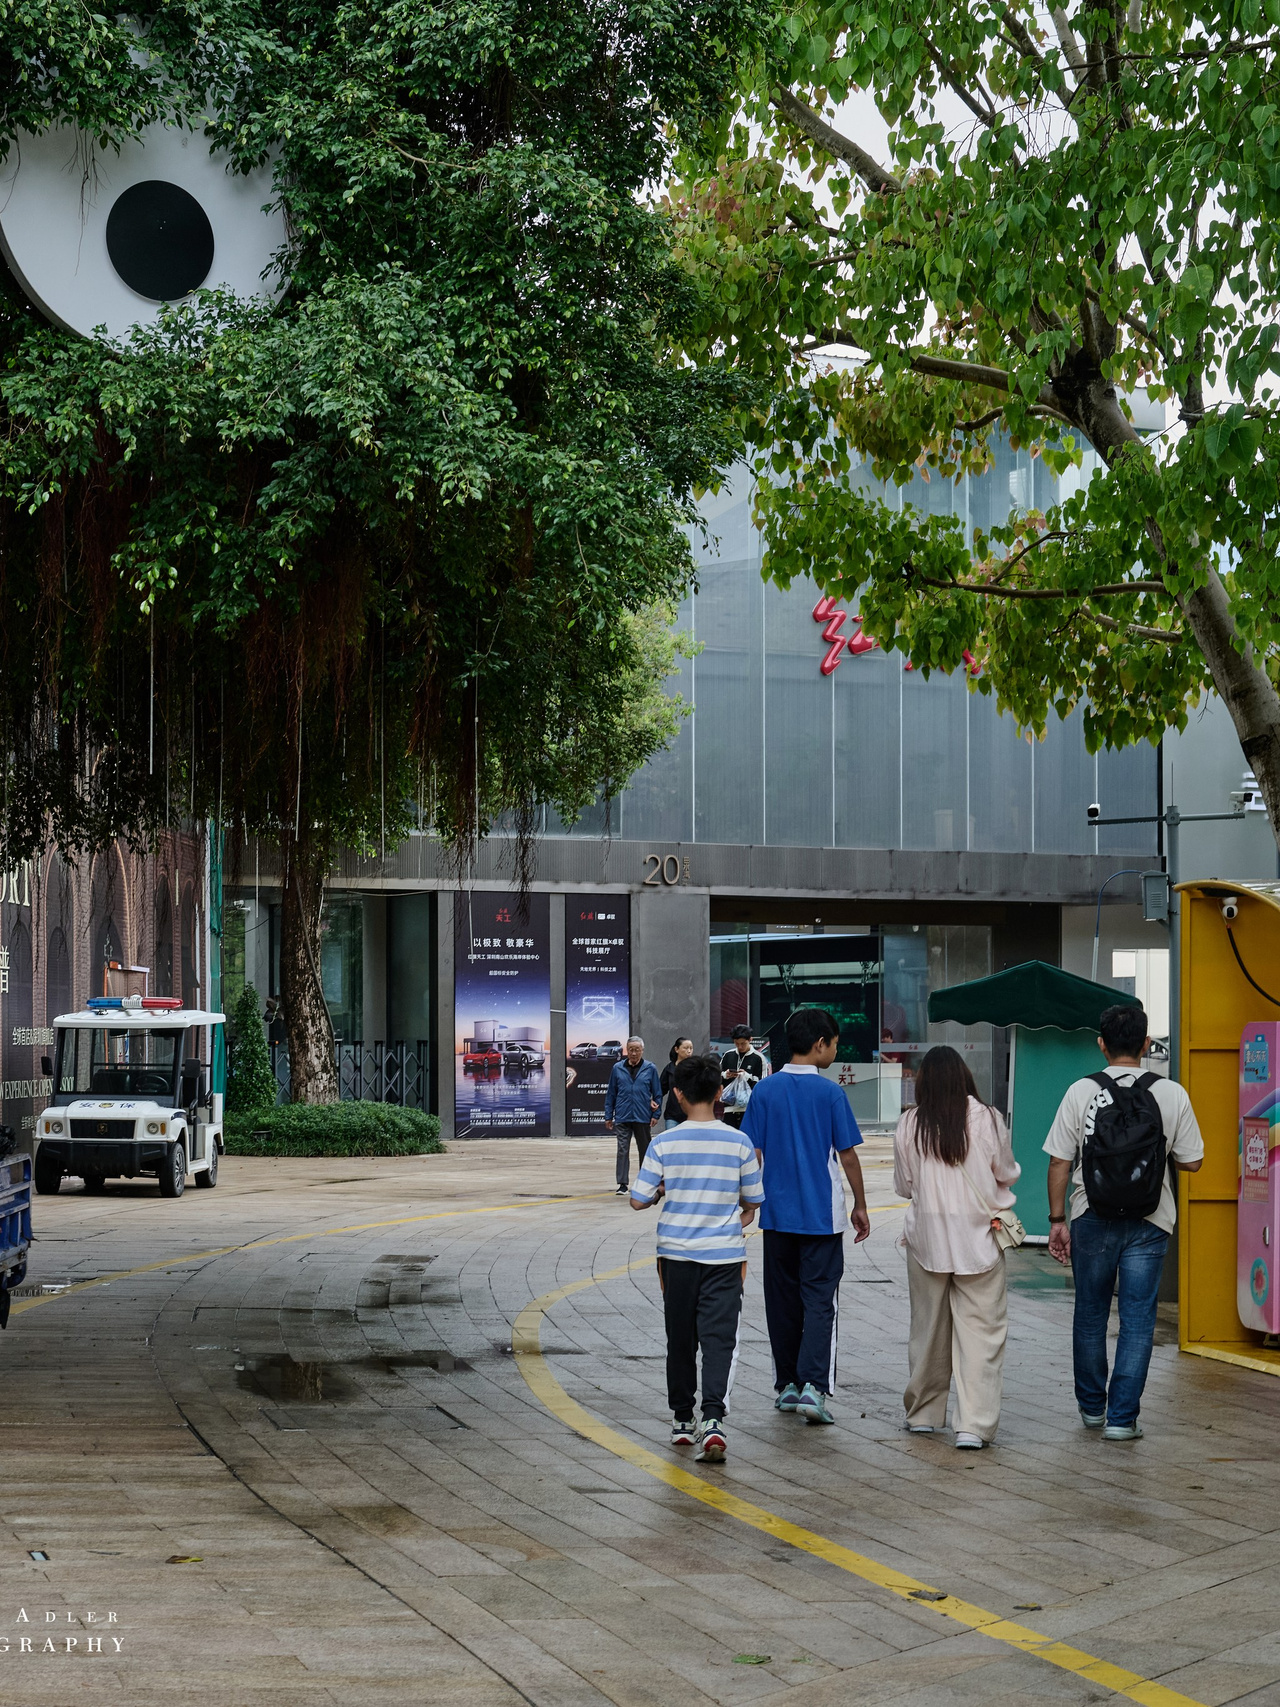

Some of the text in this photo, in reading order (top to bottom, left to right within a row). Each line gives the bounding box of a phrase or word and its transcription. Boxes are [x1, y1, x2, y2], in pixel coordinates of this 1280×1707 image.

[644, 854, 680, 885] 20
[496, 914, 511, 922] 天工
[473, 938, 534, 948] 以极致 敬豪华
[838, 1074, 856, 1085] 天工
